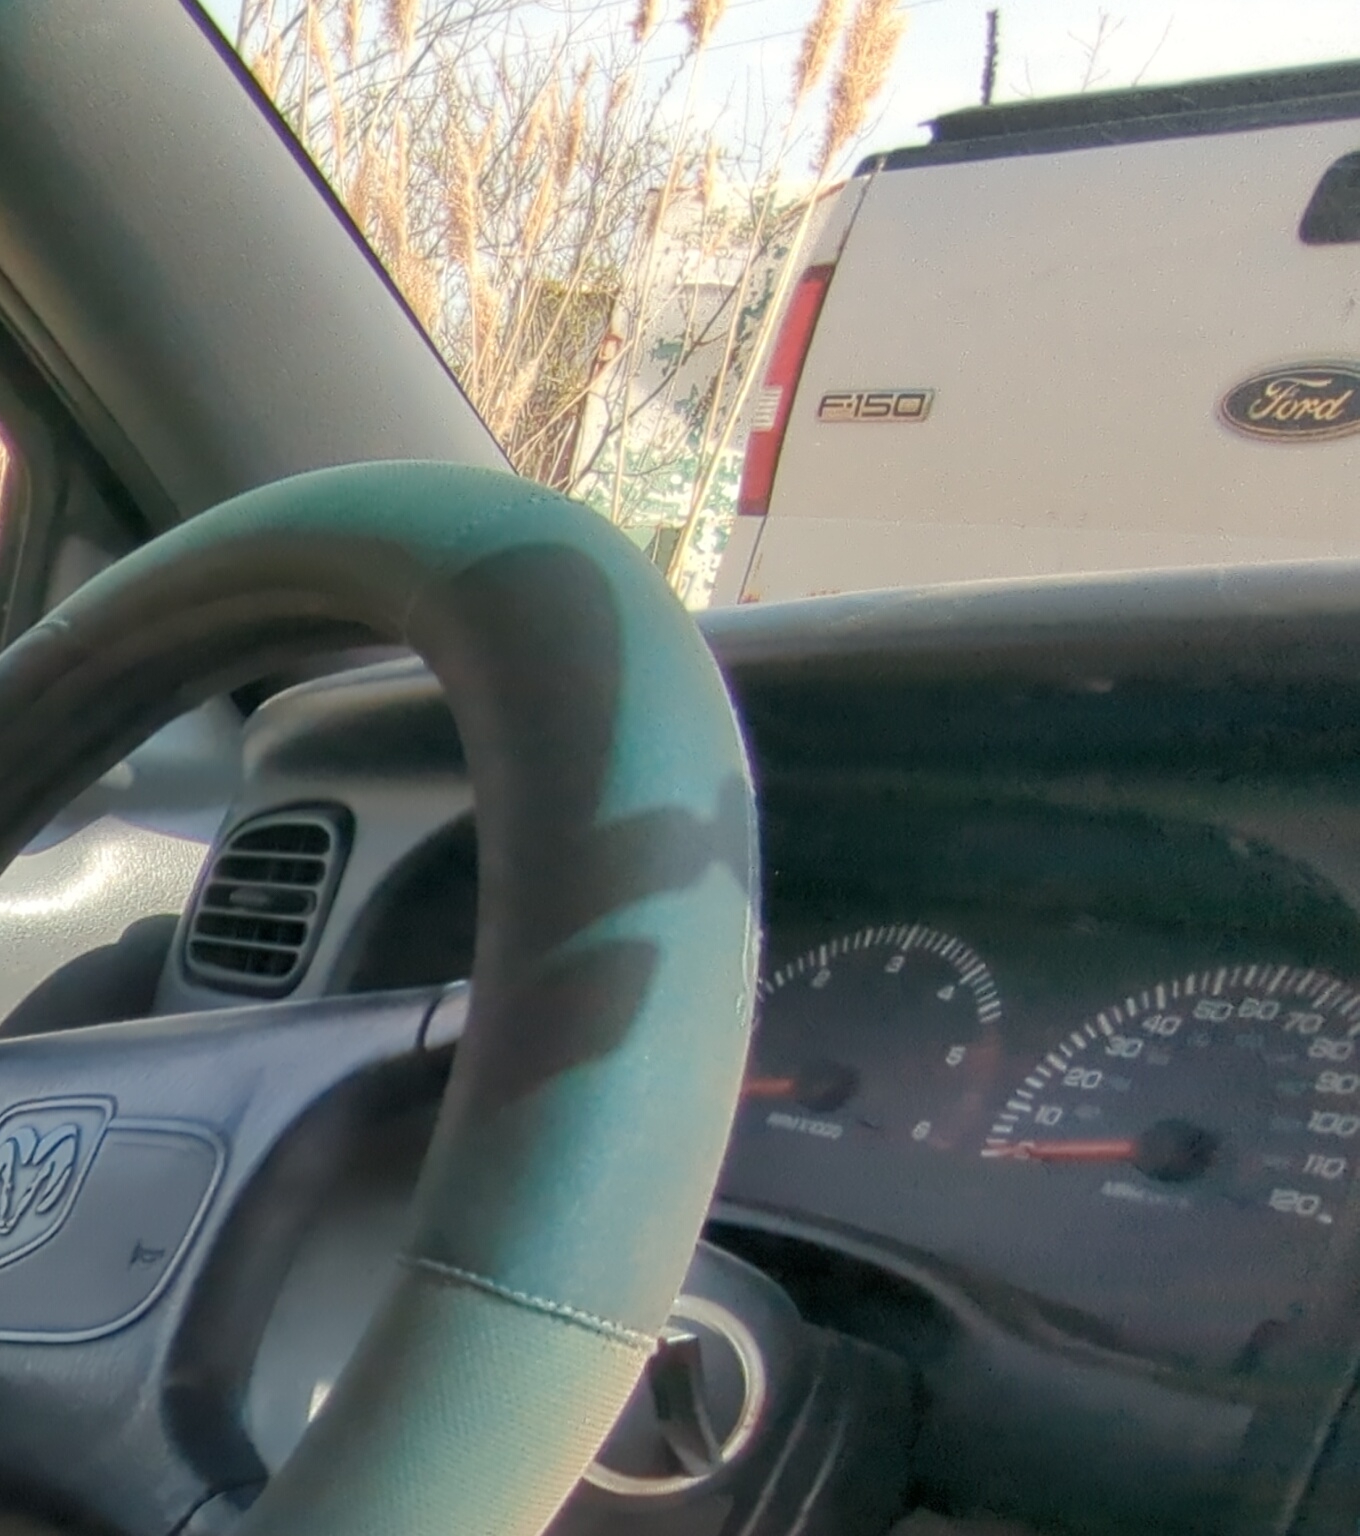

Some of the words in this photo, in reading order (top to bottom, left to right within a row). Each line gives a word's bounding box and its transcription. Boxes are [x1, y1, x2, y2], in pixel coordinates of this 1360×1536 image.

[1247, 377, 1355, 421] Ford
[1142, 1014, 1182, 1035] 40
[1284, 1012, 1326, 1034] 70
[1105, 1035, 1144, 1058] 30
[1308, 1037, 1354, 1062] 80
[1064, 1067, 1102, 1089] 20
[1314, 1071, 1360, 1094] 90
[1035, 1105, 1063, 1125] 10
[1308, 1110, 1360, 1136] 100
[1303, 1154, 1346, 1179] 110
